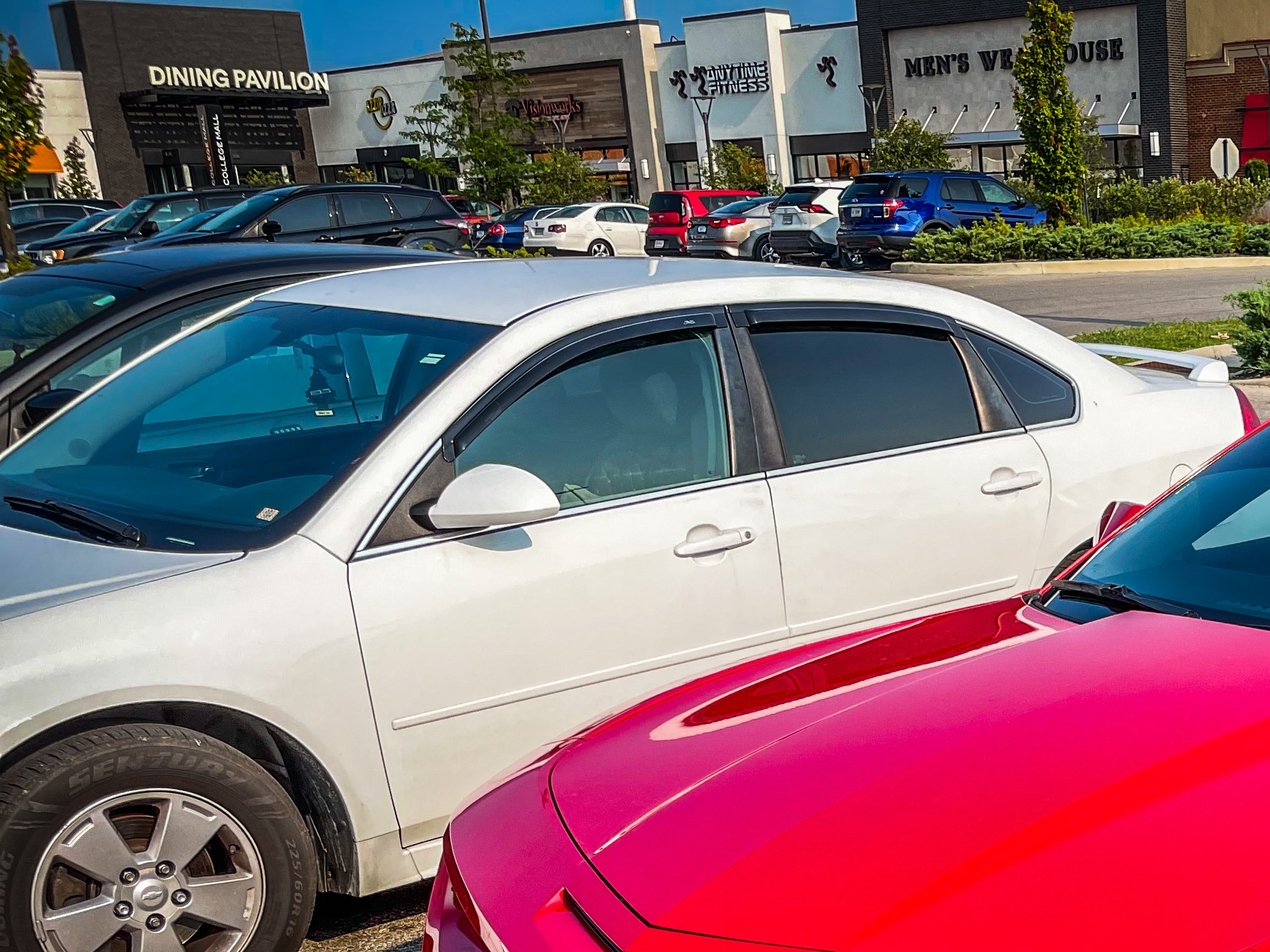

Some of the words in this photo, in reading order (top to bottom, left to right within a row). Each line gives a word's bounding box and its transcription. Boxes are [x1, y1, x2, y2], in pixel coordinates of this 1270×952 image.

[706, 61, 768, 80] ANYTIME
[904, 52, 970, 78] MEN'S
[977, 37, 1124, 71] WEOUSE
[148, 66, 231, 88] DINING
[232, 69, 330, 92] PAVILION
[708, 79, 769, 94] FITNESS
[212, 113, 222, 140] MALL
[216, 141, 230, 186] COLLEGE
[67, 750, 249, 796] SENTURY
